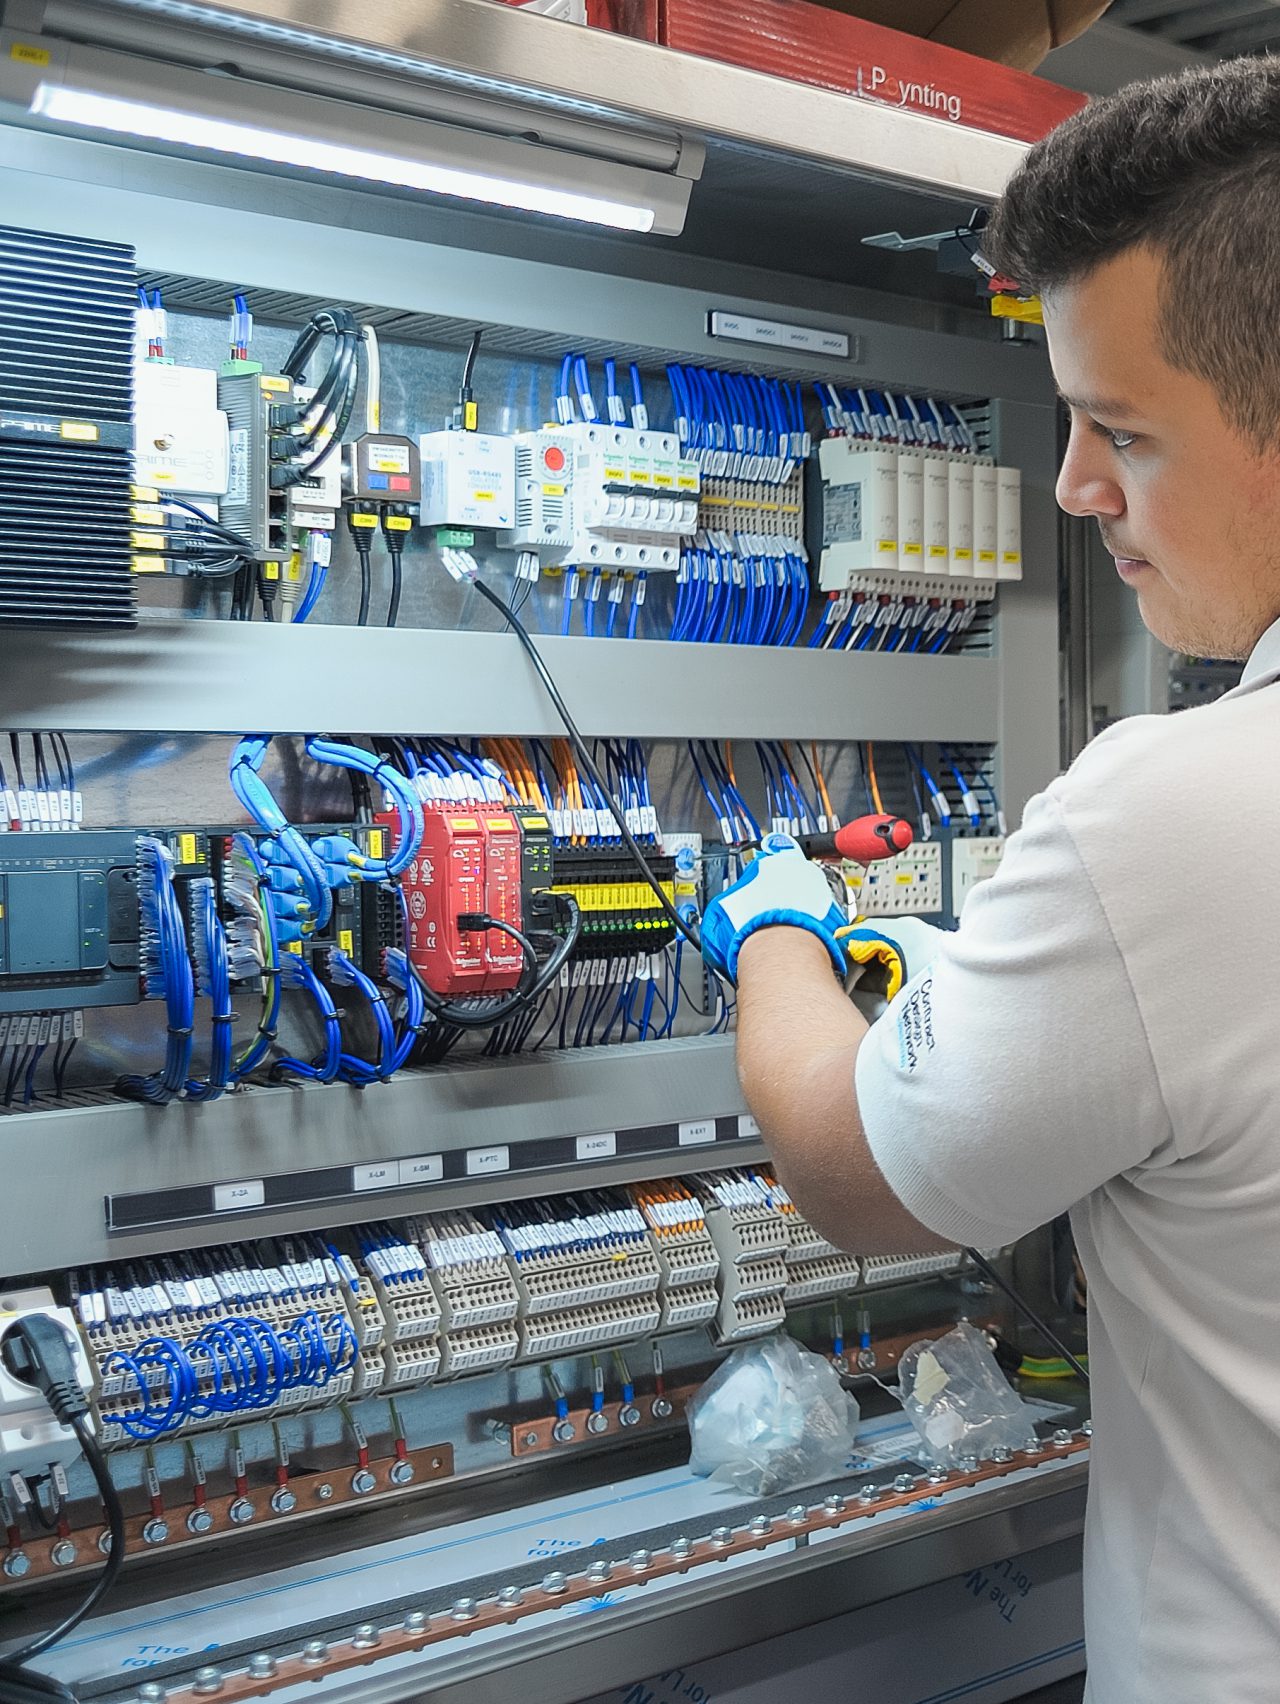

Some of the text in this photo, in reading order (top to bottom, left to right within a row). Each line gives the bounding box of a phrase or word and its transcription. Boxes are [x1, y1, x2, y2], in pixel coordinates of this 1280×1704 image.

[871, 65, 961, 120] Poynting
[1010, 1570, 1033, 1597] for
[988, 1585, 1017, 1624] The
[120, 1657, 161, 1669] for
[137, 1644, 189, 1655] The
